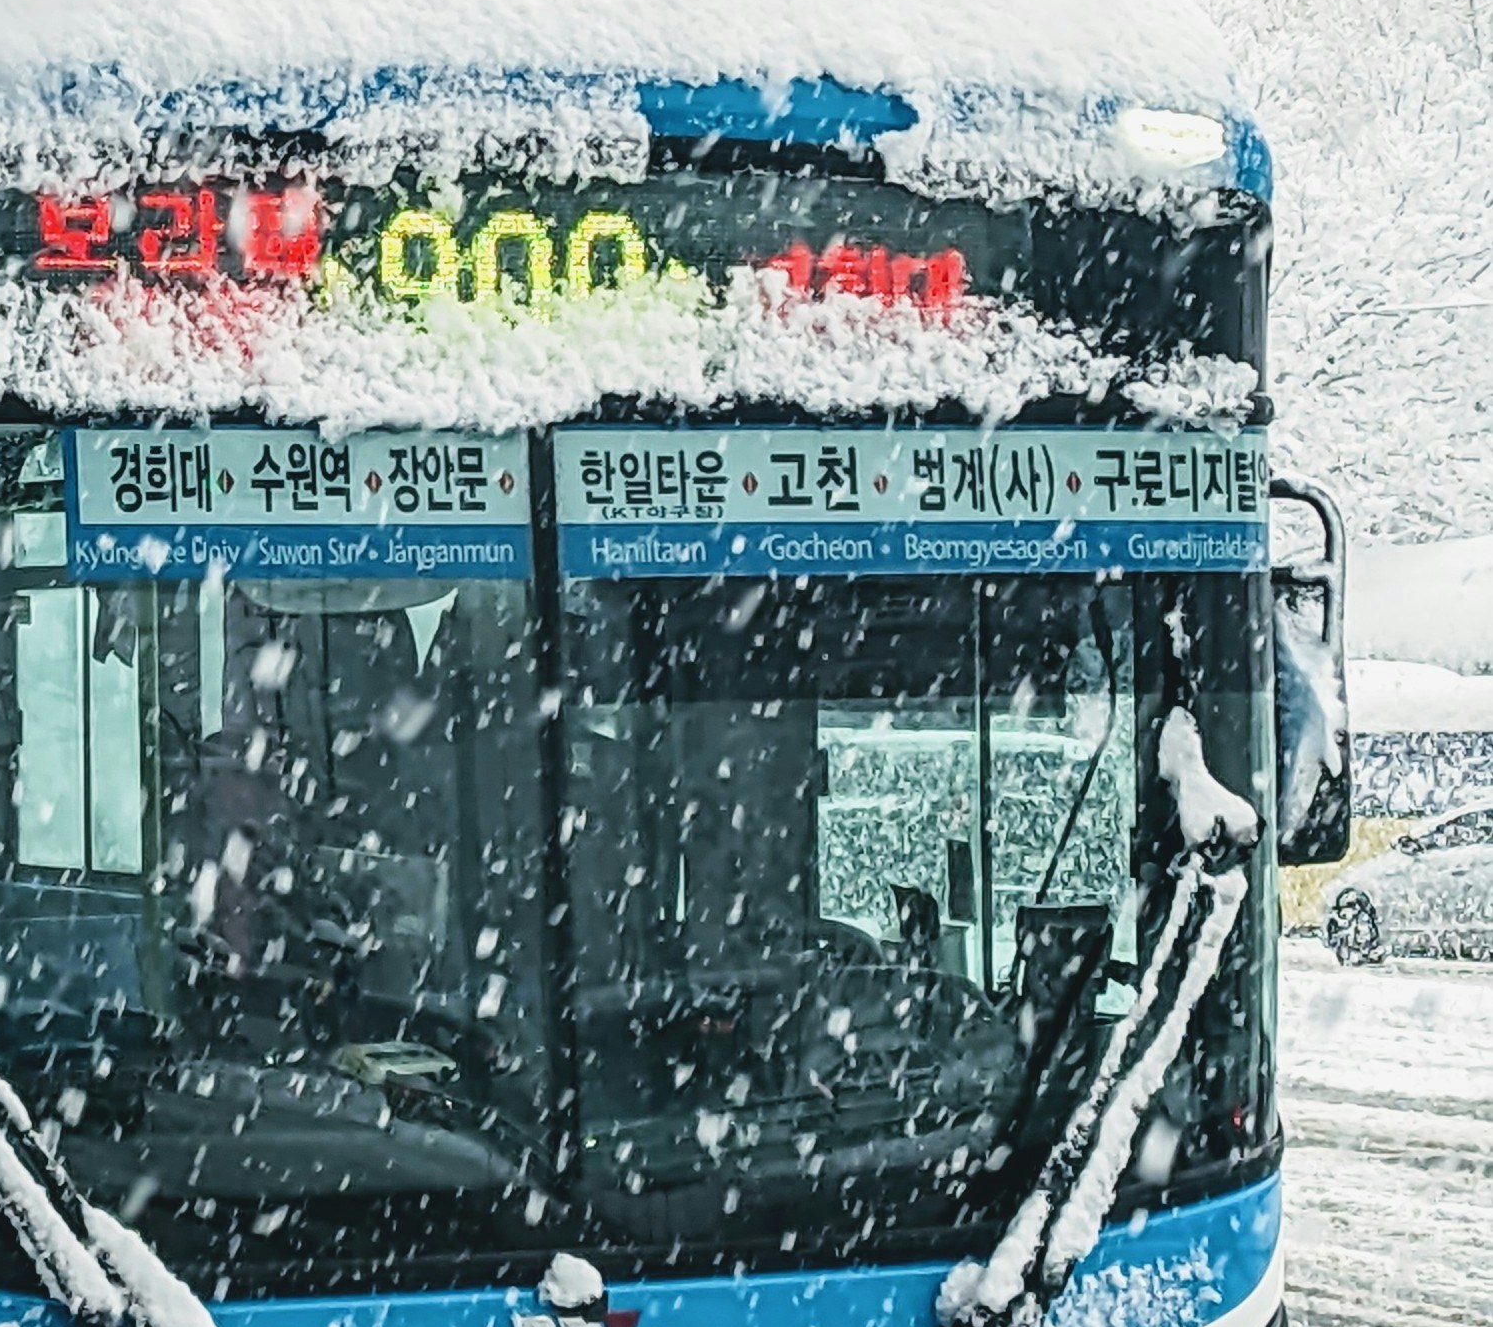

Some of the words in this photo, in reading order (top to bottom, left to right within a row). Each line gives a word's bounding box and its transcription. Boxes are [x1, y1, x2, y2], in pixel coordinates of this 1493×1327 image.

[110, 442, 213, 513] 경희대
[250, 442, 352, 513] 수원역
[387, 444, 489, 513] 장안문
[579, 449, 730, 505] 한일타운
[767, 444, 861, 512] 고천
[912, 443, 1055, 516] 범계(사)
[258, 535, 323, 566] Suwon
[383, 539, 514, 570] Janganmun
[590, 537, 707, 565] Haniltaun
[766, 531, 874, 561] Gocheon
